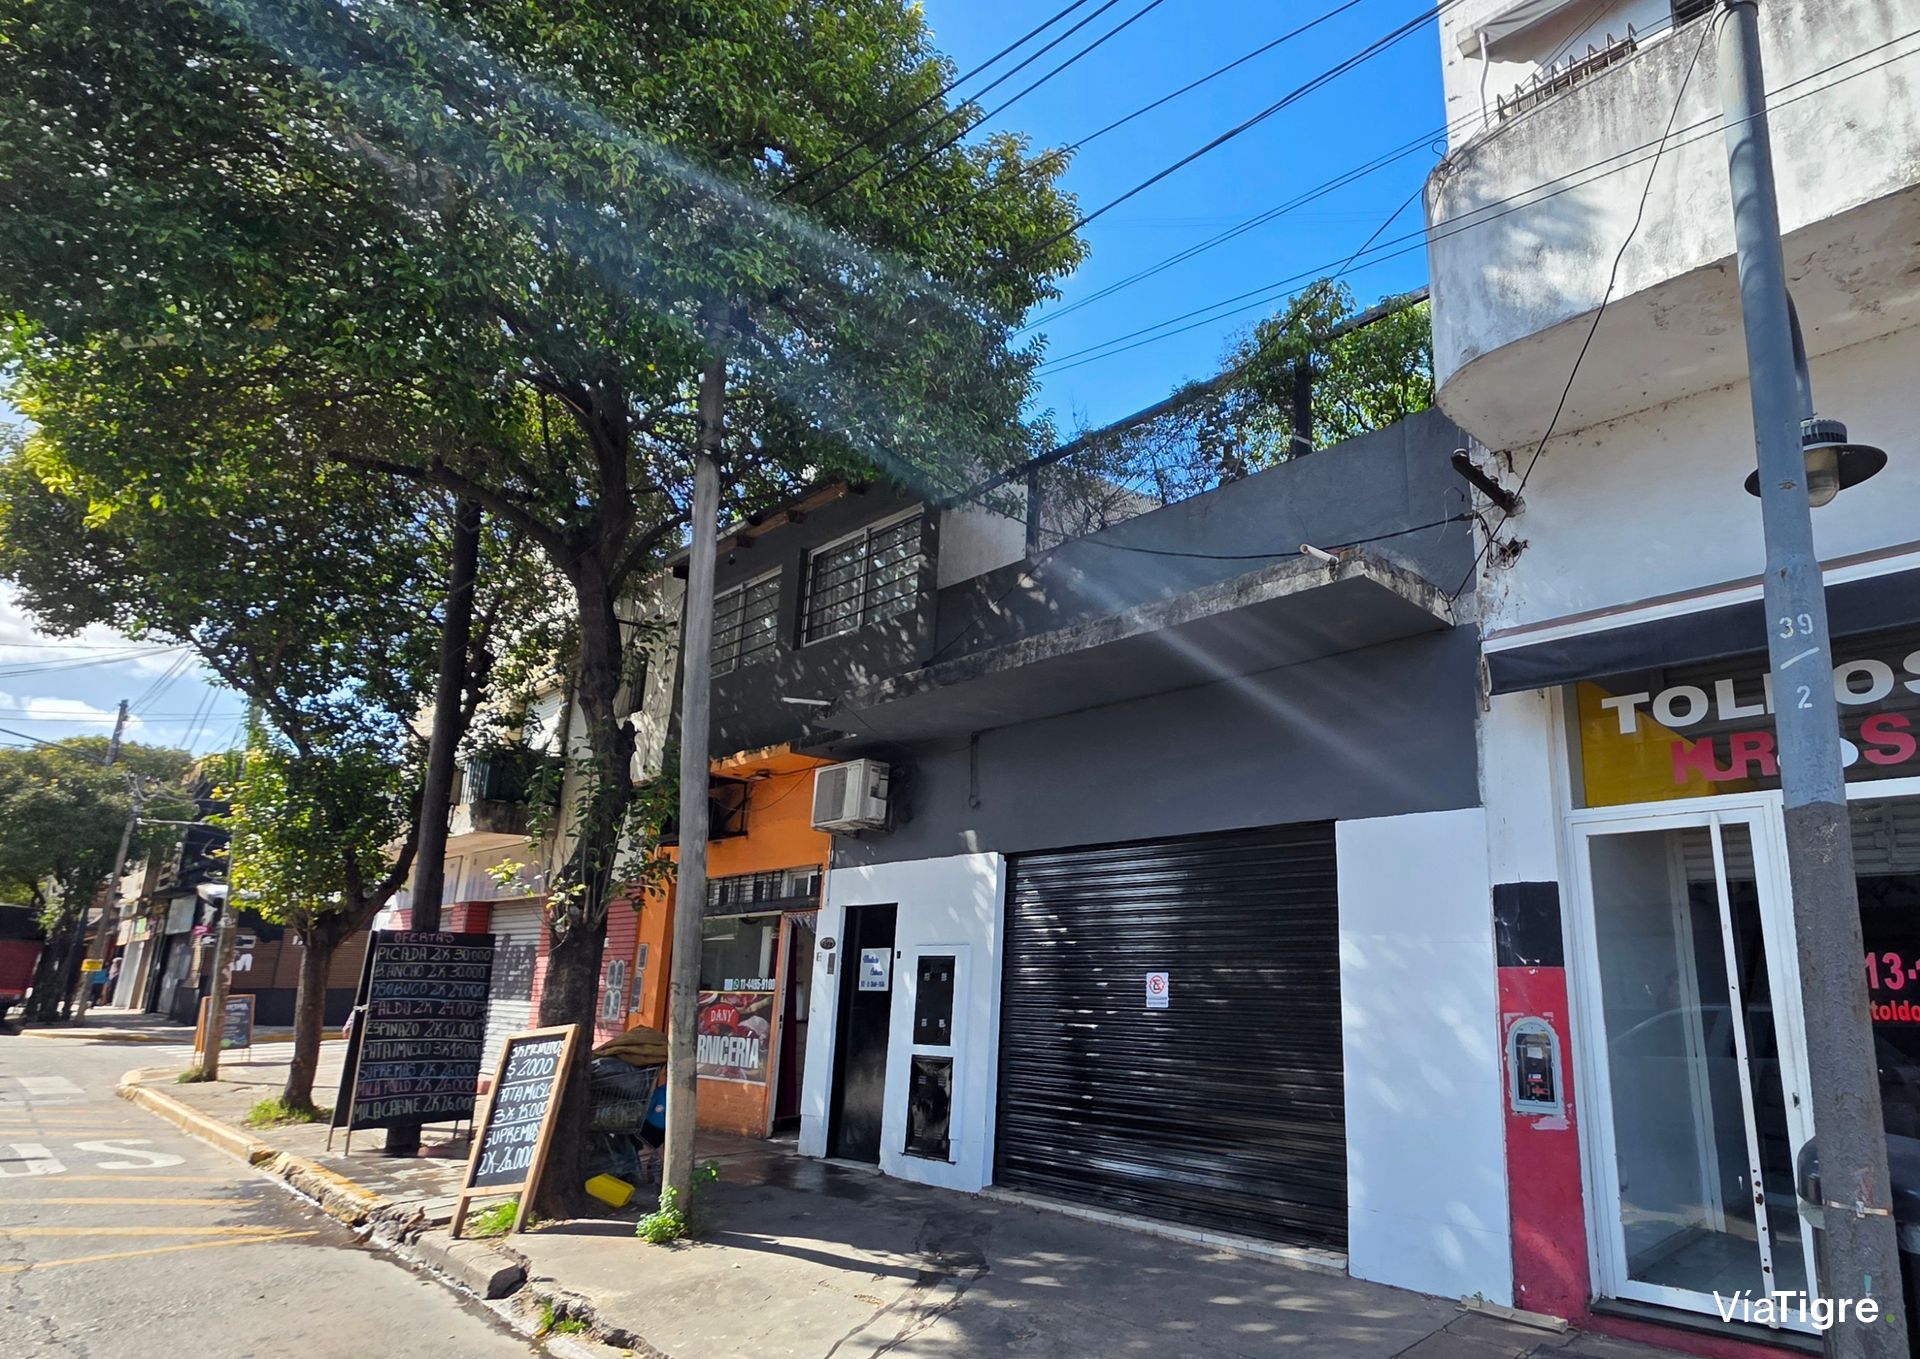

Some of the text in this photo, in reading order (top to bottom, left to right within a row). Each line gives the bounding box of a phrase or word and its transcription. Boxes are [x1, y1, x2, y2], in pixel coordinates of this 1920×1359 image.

[1601, 650, 1920, 735] TOLO
[394, 932, 455, 944] OFERTAS
[377, 946, 427, 961] PICADA
[710, 1008, 735, 1023] DANY
[366, 1022, 420, 1038] ESPINAZO
[517, 1057, 554, 1077] 2000
